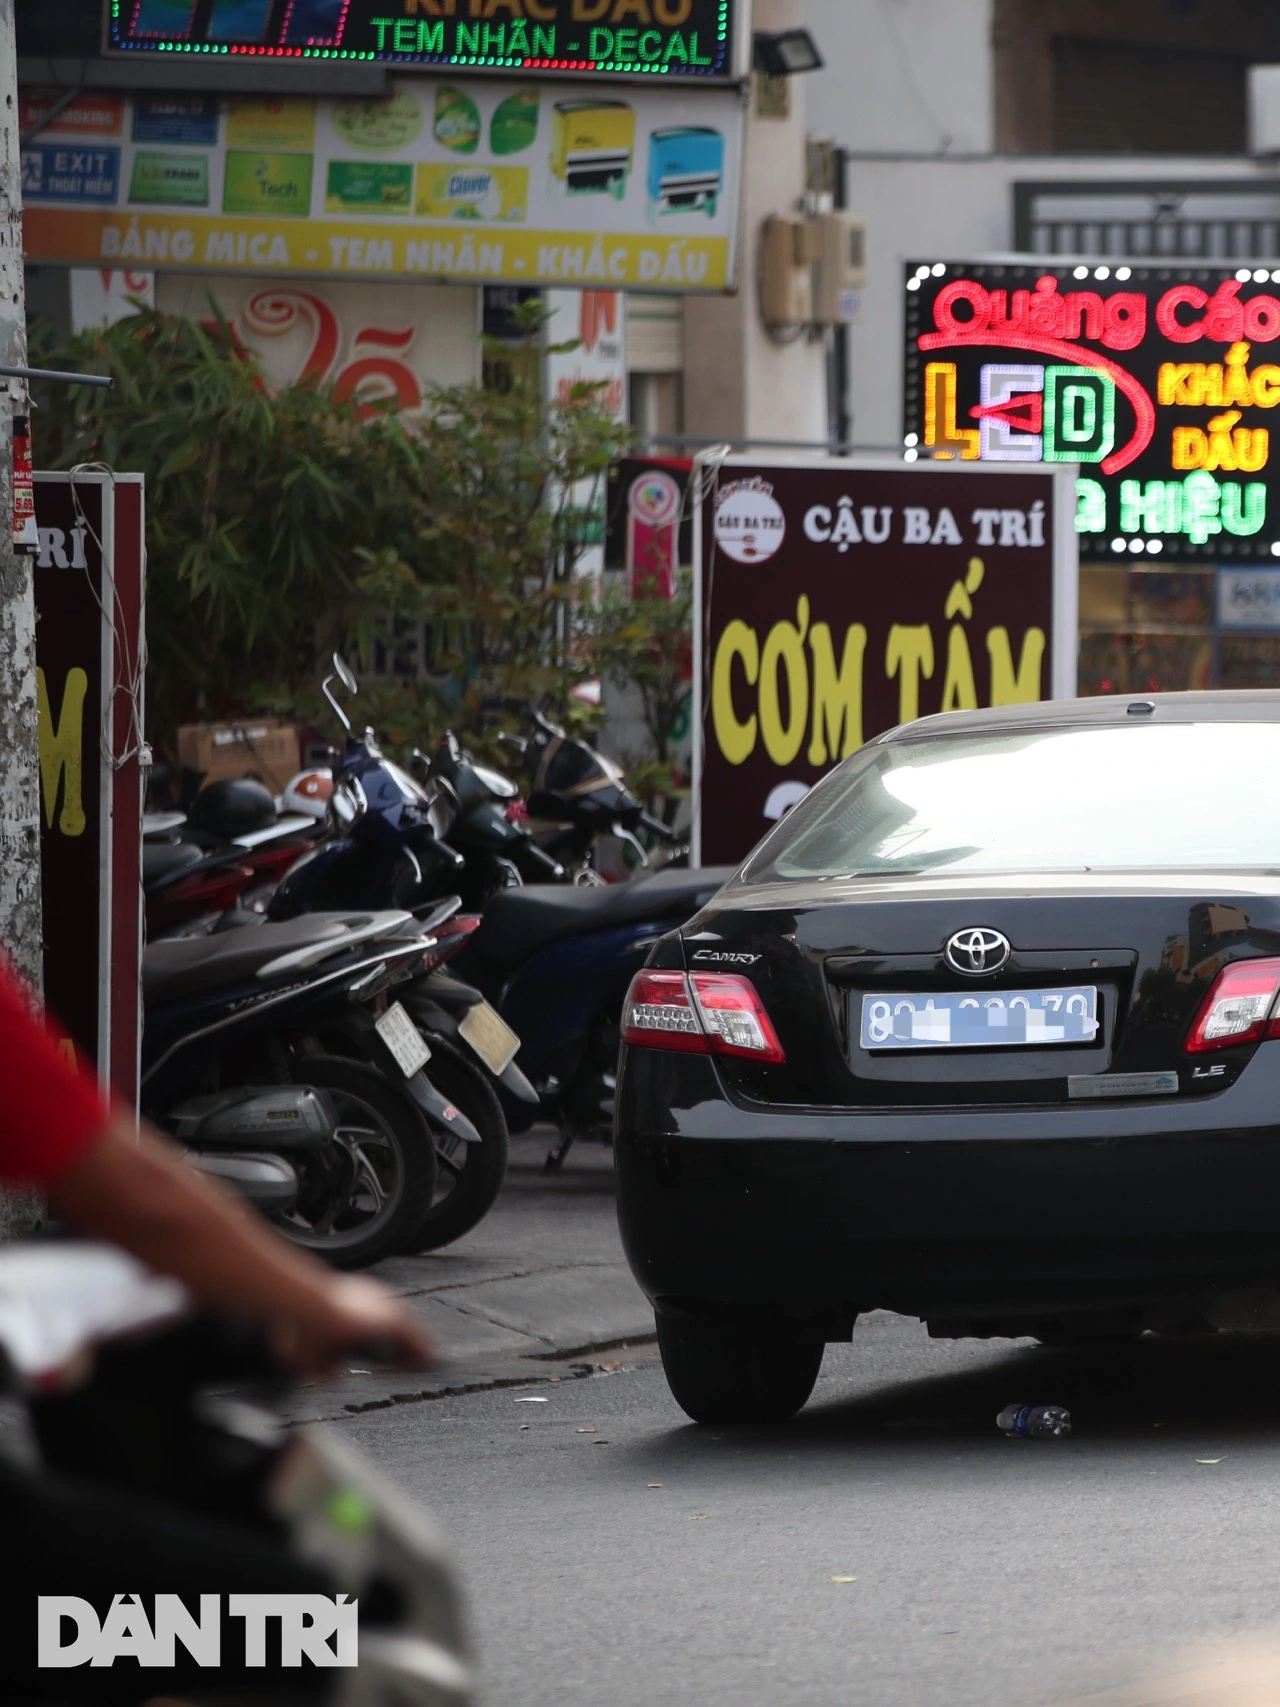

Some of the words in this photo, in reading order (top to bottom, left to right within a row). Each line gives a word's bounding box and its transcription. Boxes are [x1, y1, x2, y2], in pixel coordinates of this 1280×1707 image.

[370, 18, 444, 52] TEM
[455, 18, 555, 58] NHÃN
[589, 27, 712, 66] DECAL
[54, 153, 109, 174] EXIT
[260, 180, 298, 198] Tech
[101, 215, 195, 262] BẢNG
[204, 231, 290, 266] MICA
[329, 236, 394, 270] TEM
[405, 233, 504, 274] NHÃN
[537, 234, 629, 280] KHẮC
[637, 239, 709, 282] DẤU
[933, 275, 1147, 351] Quảng
[925, 361, 1116, 463] LED
[1172, 410, 1270, 473] DẤU
[803, 495, 893, 553] CẬU
[903, 507, 963, 545] BA
[972, 499, 1046, 548] TRÍ
[1120, 468, 1267, 545] HIỆU
[36, 515, 88, 569] RÍ
[712, 593, 868, 767] CƠM
[885, 556, 1046, 725] TẤM
[1192, 1064, 1227, 1079] LE
